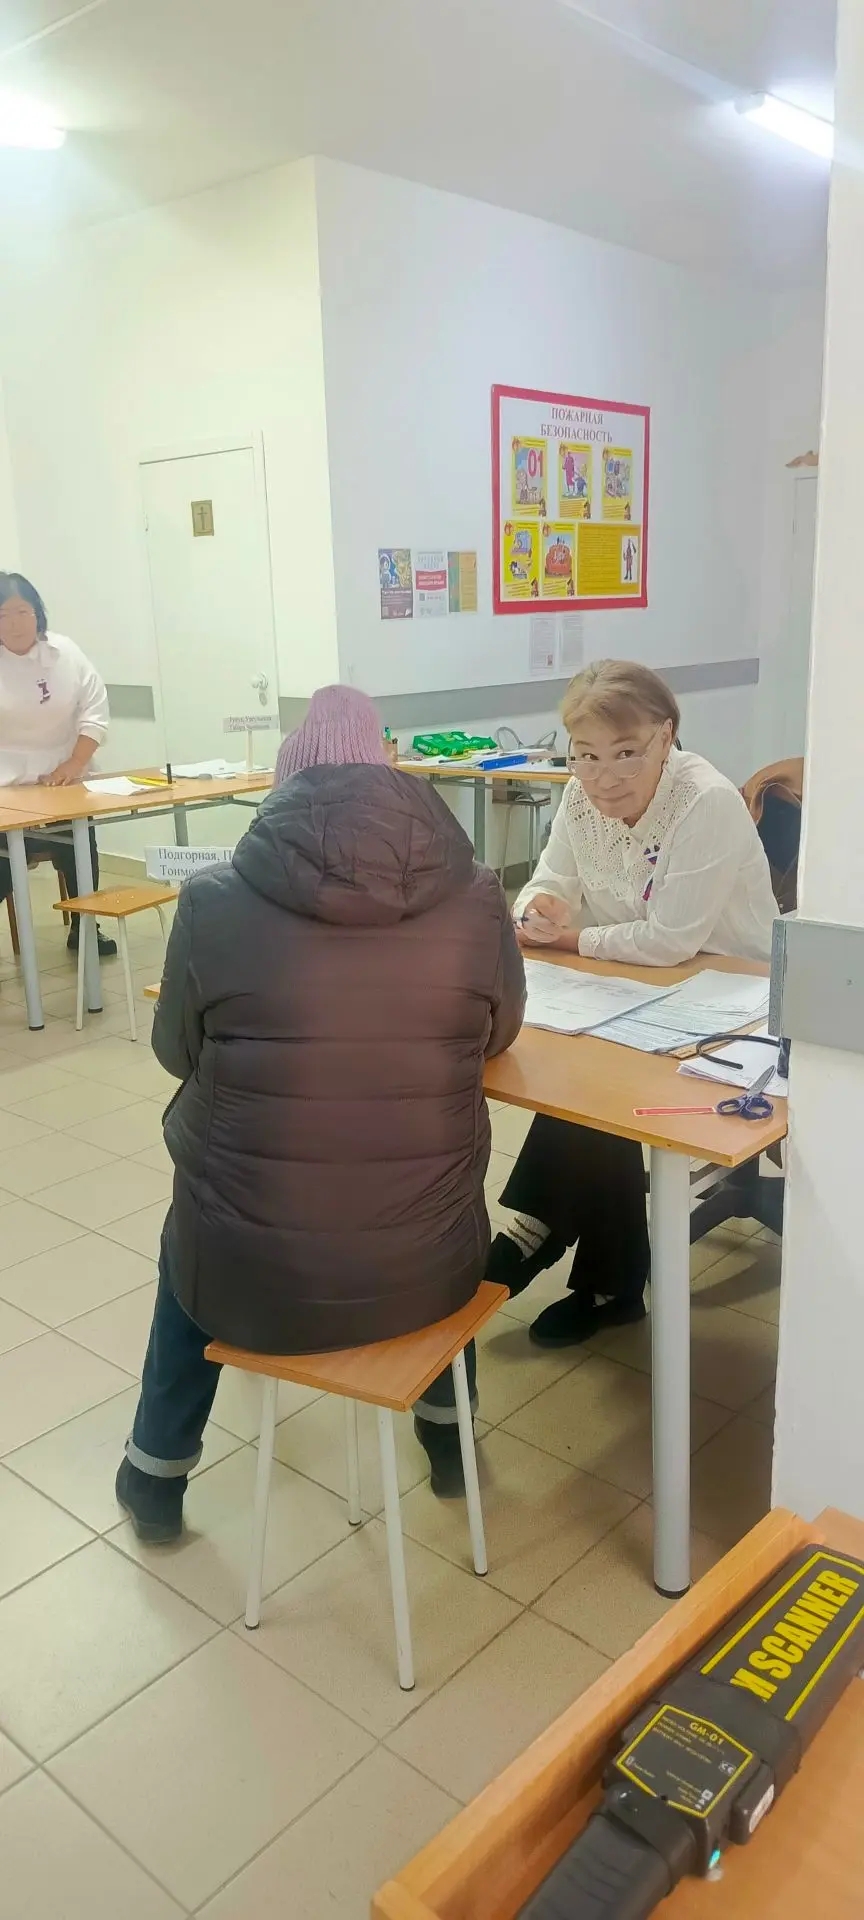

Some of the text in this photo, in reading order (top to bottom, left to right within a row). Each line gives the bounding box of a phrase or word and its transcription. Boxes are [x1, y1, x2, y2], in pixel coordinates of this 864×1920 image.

[551, 407, 604, 425] ПОЖАРНАЯ
[540, 424, 613, 442] БЕЗОПАСНОСТЬ
[527, 449, 544, 477] 01
[158, 848, 220, 863] Подгорная,
[748, 1570, 860, 1680] SCANNER
[689, 1721, 725, 1745] GM-01
